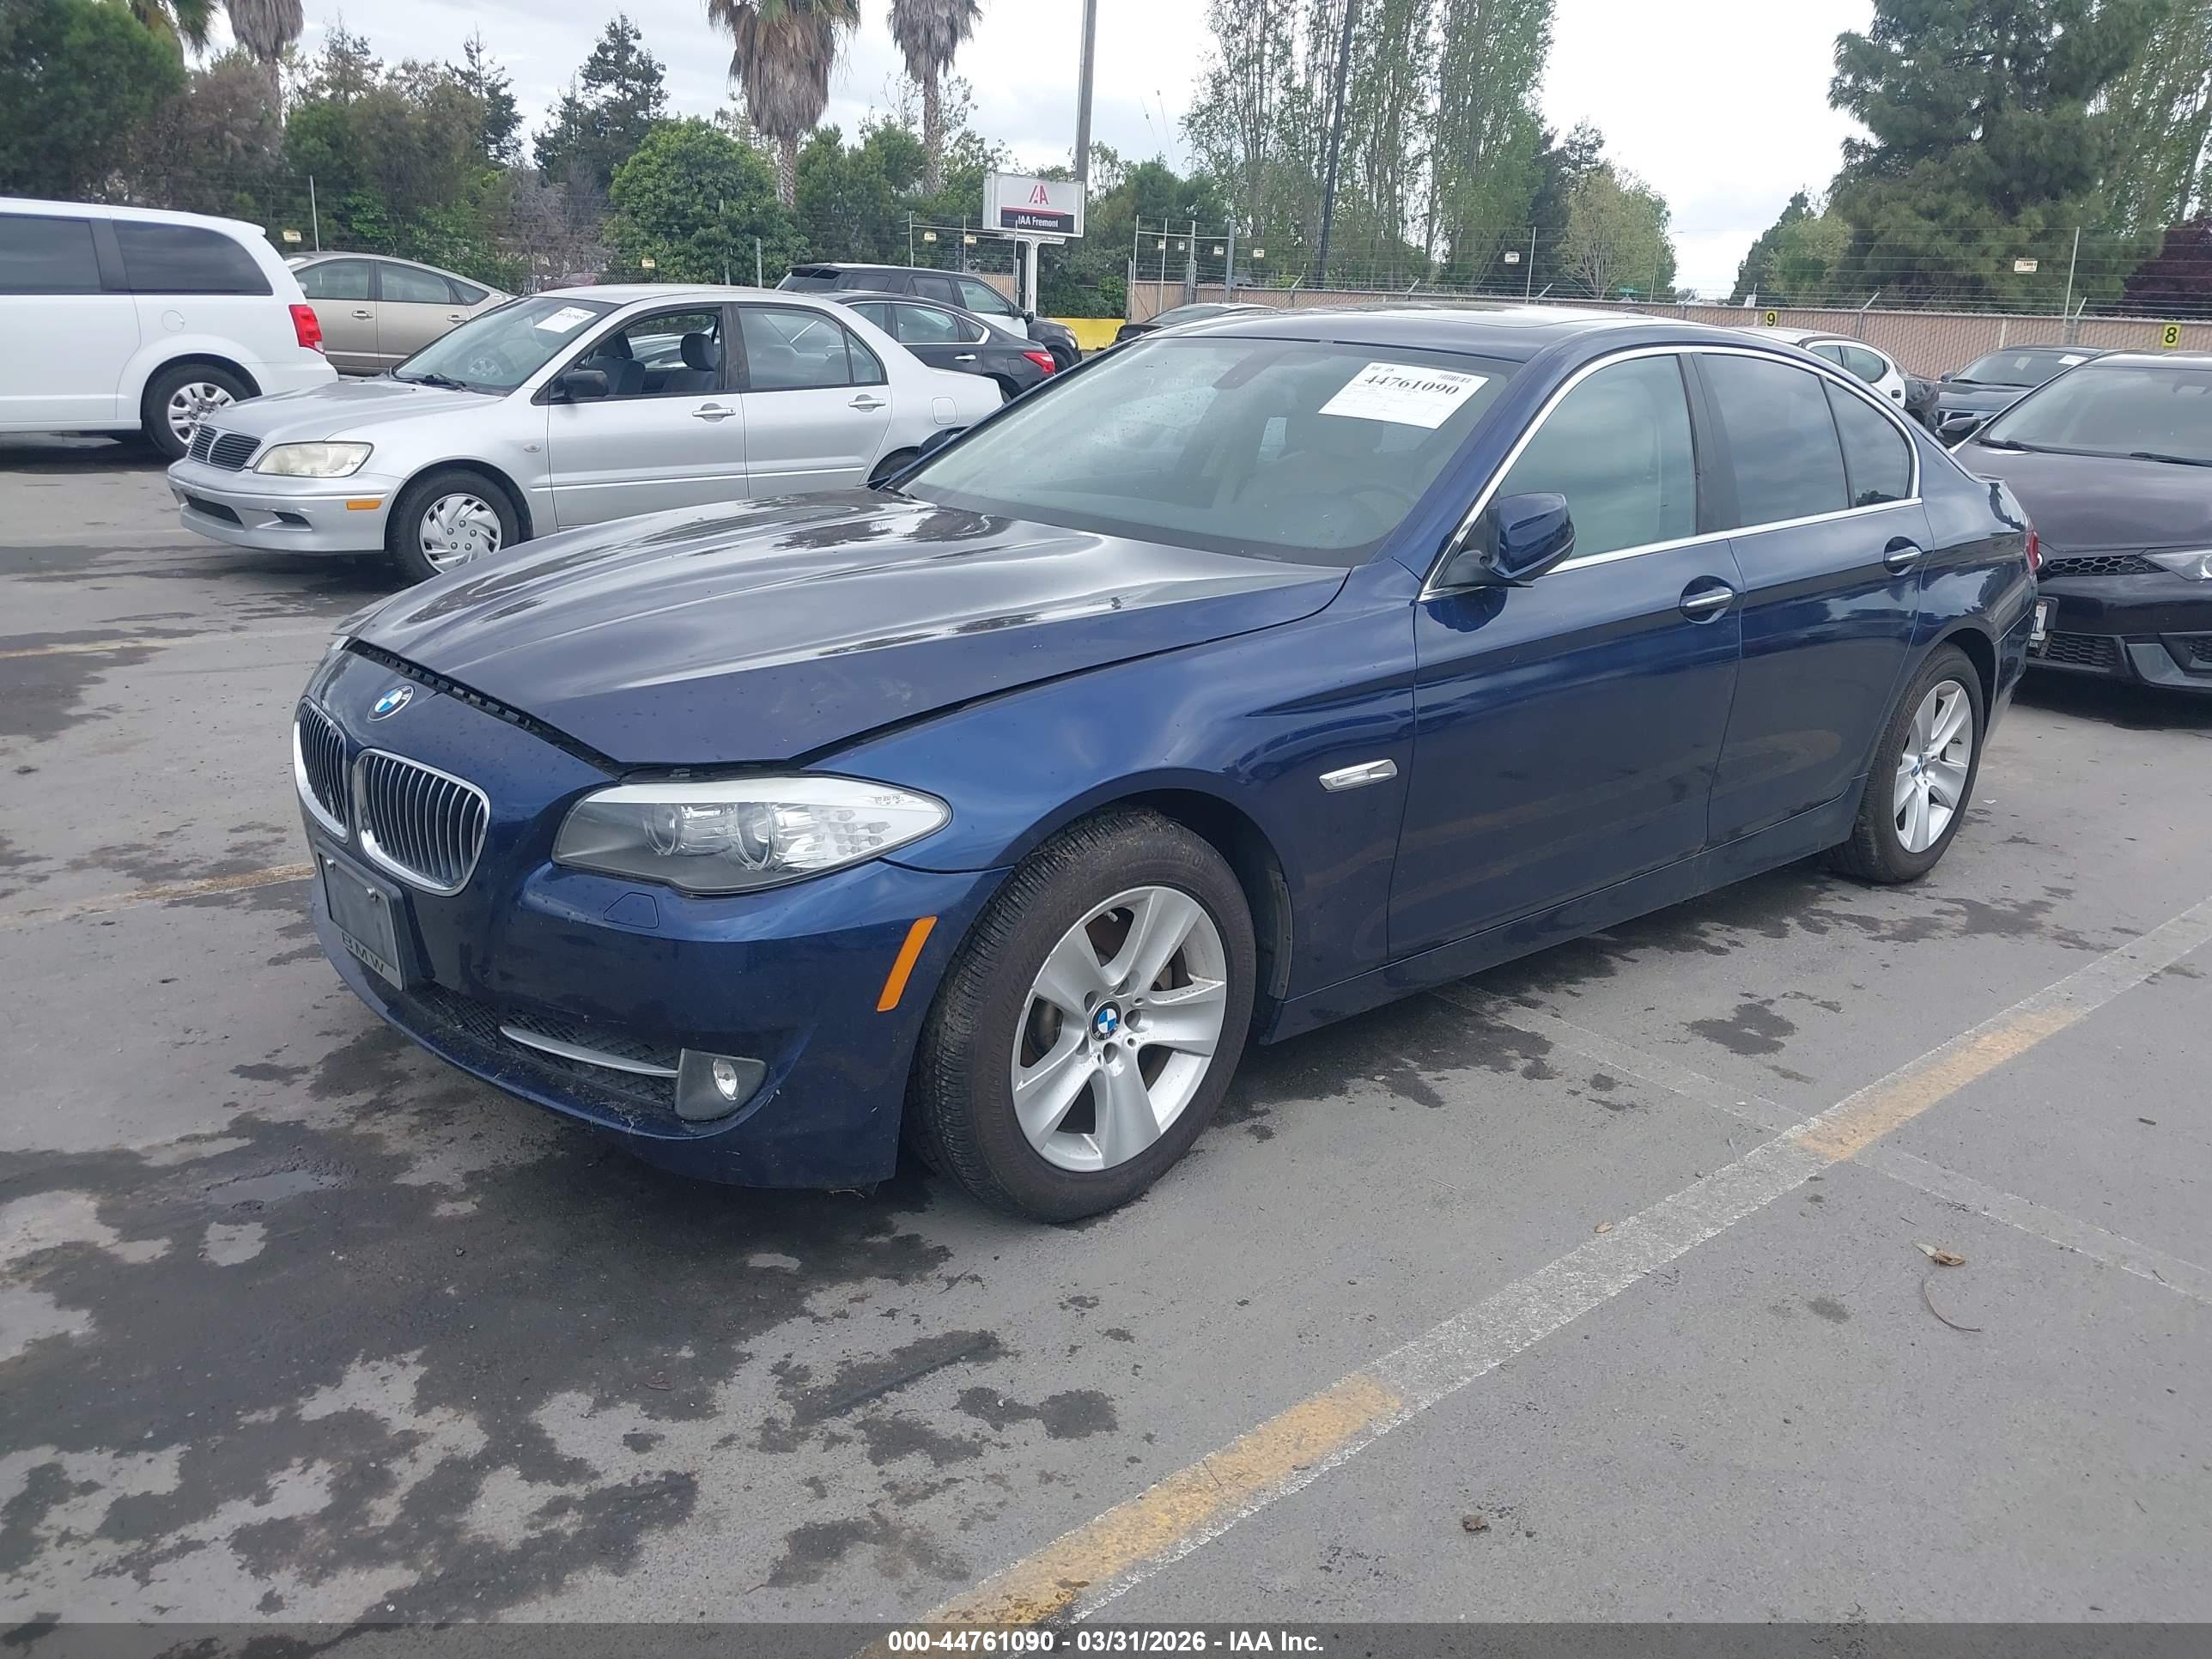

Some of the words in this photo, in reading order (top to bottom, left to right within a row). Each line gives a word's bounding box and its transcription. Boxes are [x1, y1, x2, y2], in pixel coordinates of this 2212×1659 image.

[1018, 215, 1030, 226] IAA
[1032, 216, 1059, 228] Fremont
[1766, 312, 1776, 327] 9
[2165, 326, 2178, 343] 8
[1364, 374, 1460, 395] 44761090
[342, 932, 384, 974] BMW
